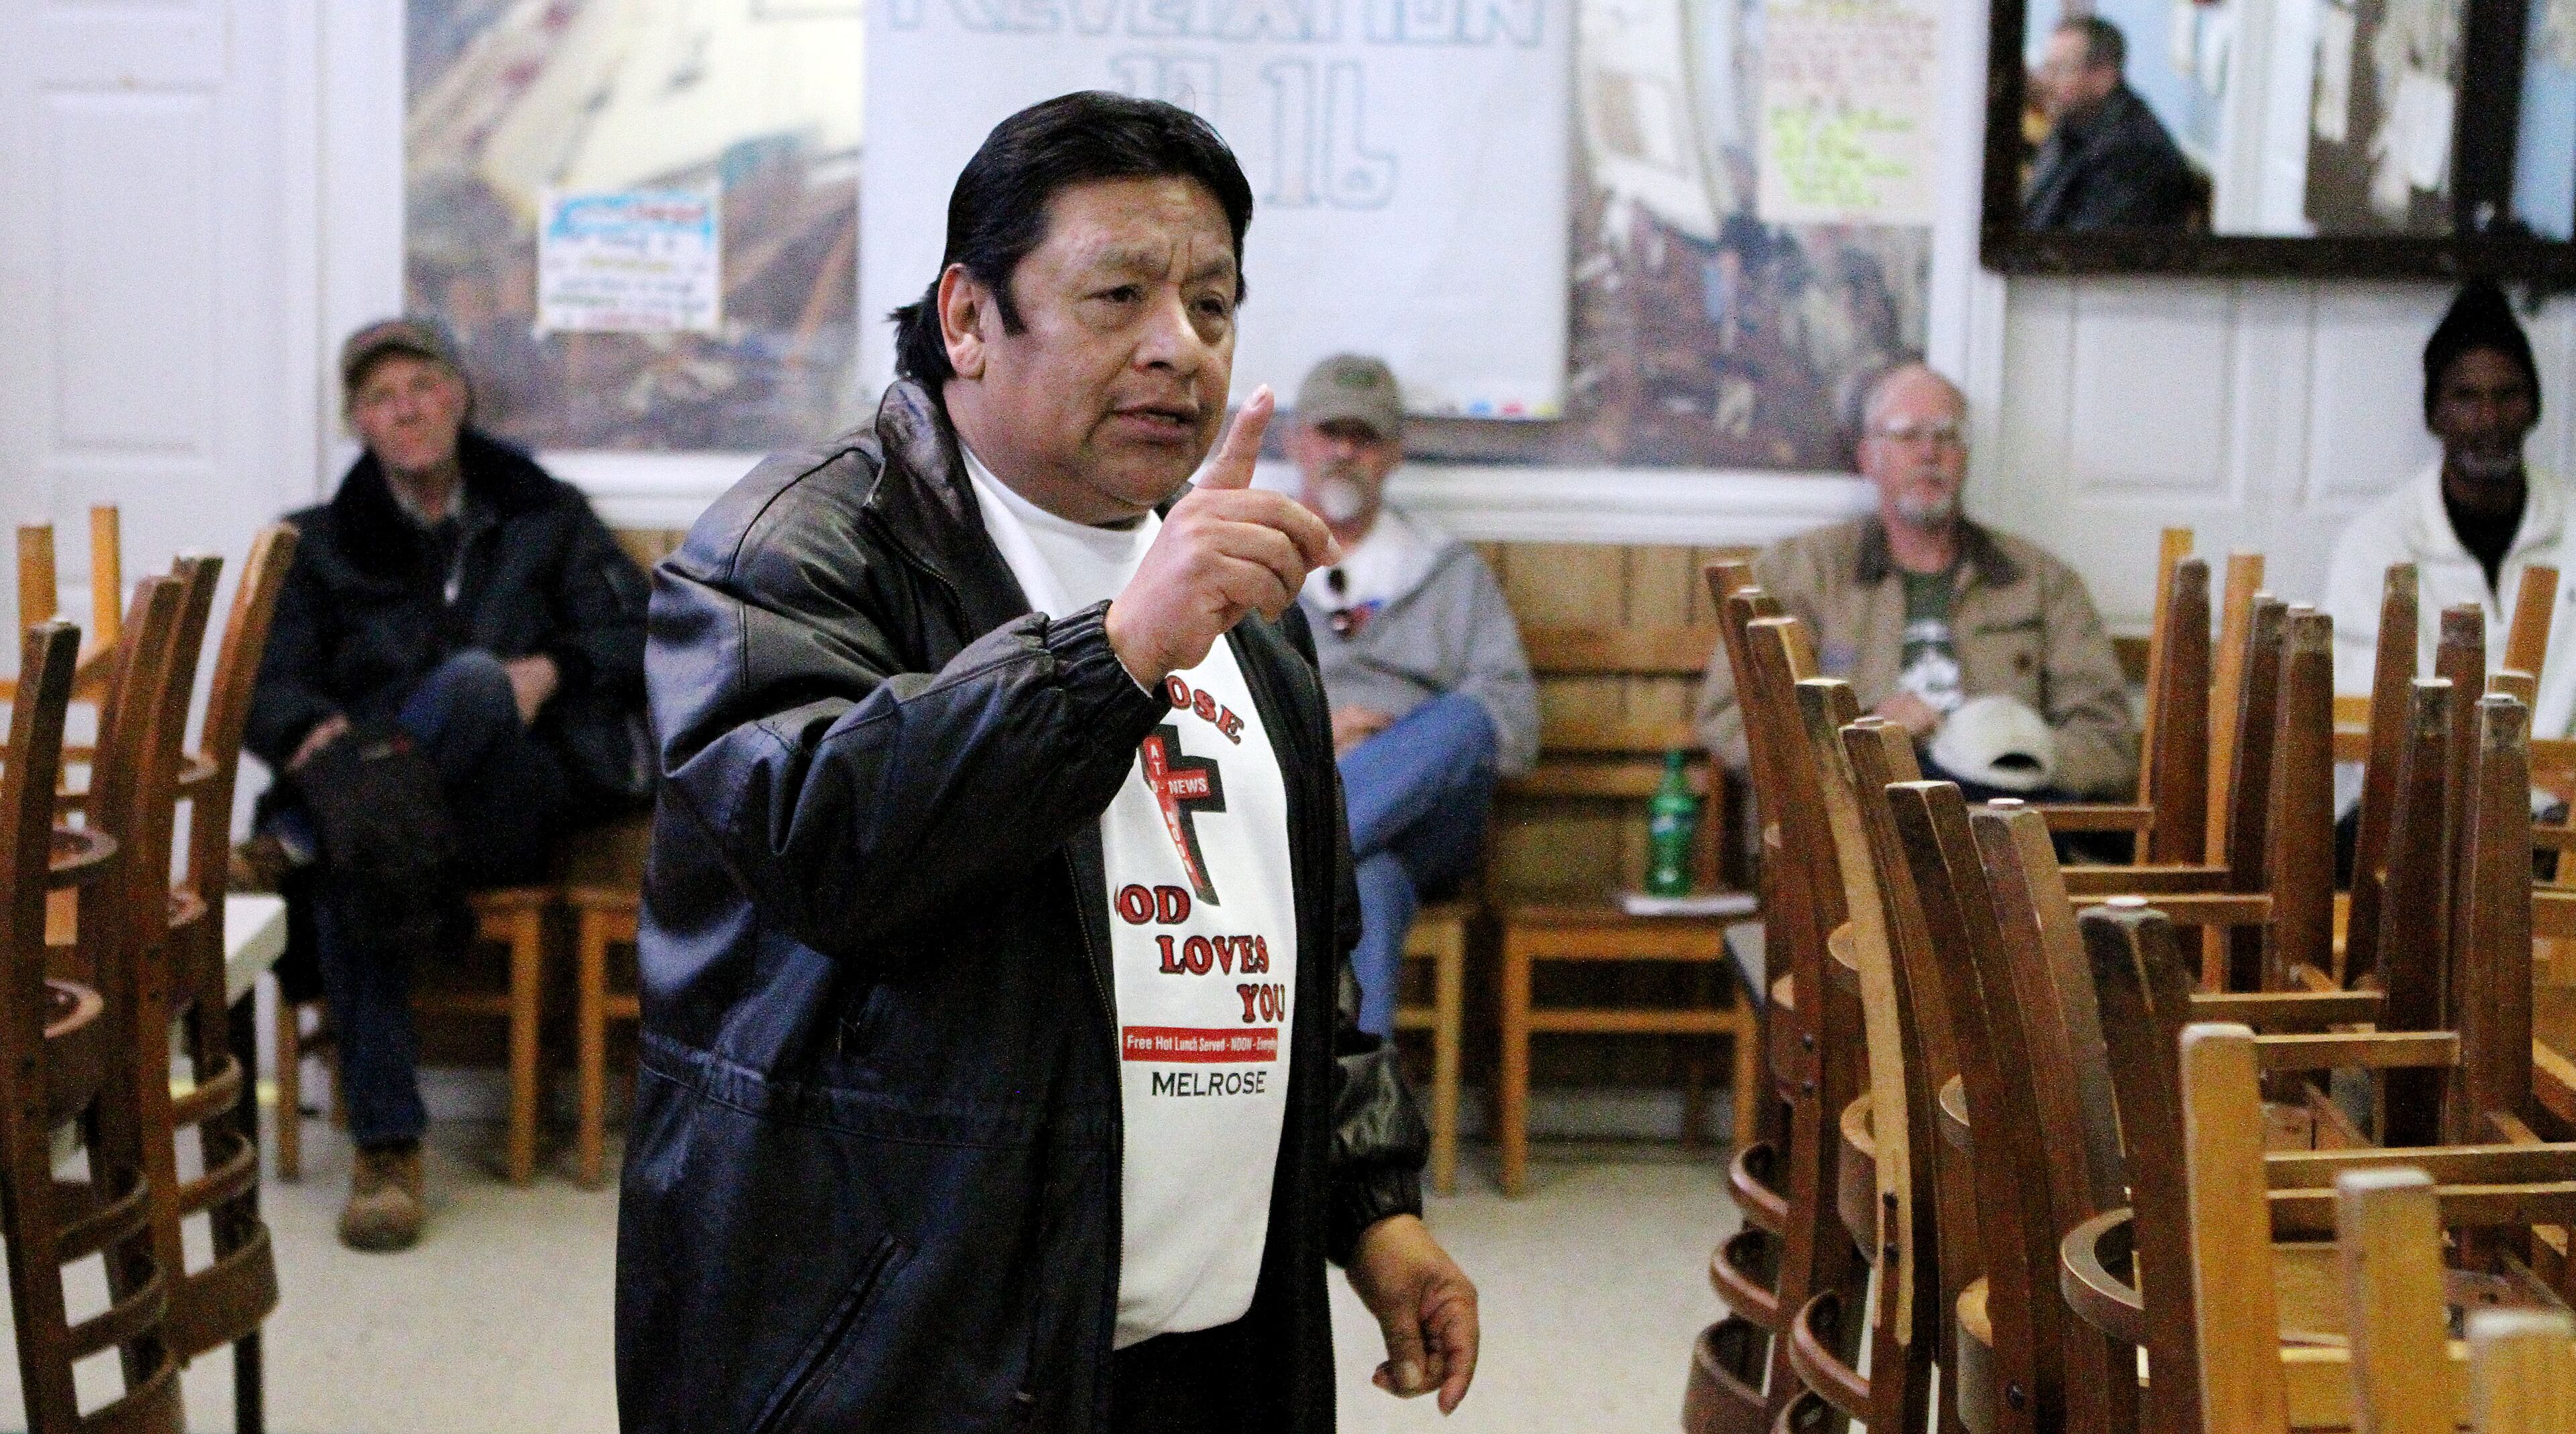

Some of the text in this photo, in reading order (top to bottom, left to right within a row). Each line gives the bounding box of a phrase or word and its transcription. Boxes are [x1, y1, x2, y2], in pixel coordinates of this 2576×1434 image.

[1168, 778, 1208, 795] NEWS
[1114, 884, 1191, 925] OD
[1155, 934, 1269, 976] LOVES
[1236, 983, 1285, 1023] YOU
[1127, 1034, 1152, 1050] Free
[1155, 1035, 1173, 1050] Hot
[1175, 1037, 1197, 1052] Lunch
[1199, 1037, 1226, 1052] Served
[1231, 1037, 1252, 1052] NOON
[1152, 1071, 1267, 1096] MELROSE
